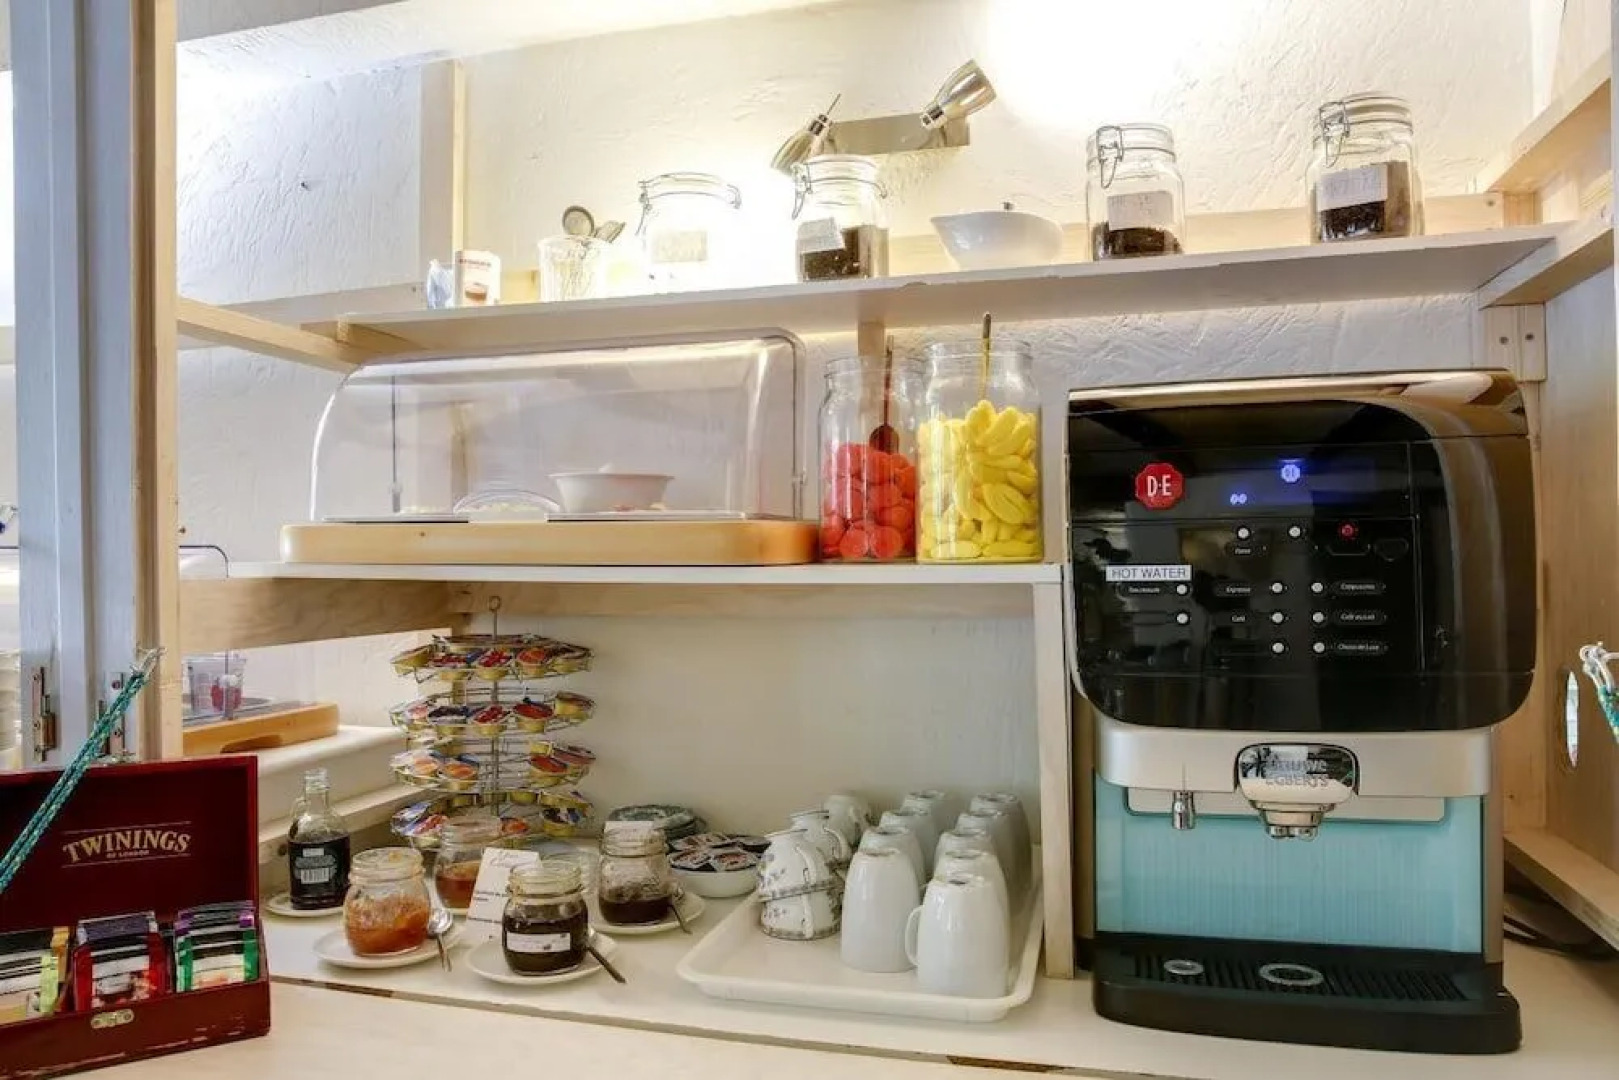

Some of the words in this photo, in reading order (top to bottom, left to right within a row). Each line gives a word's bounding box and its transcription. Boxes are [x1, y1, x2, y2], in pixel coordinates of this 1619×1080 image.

[1112, 568, 1137, 579] HOT
[1141, 567, 1186, 579] WATER
[62, 829, 192, 863] TWININGS
